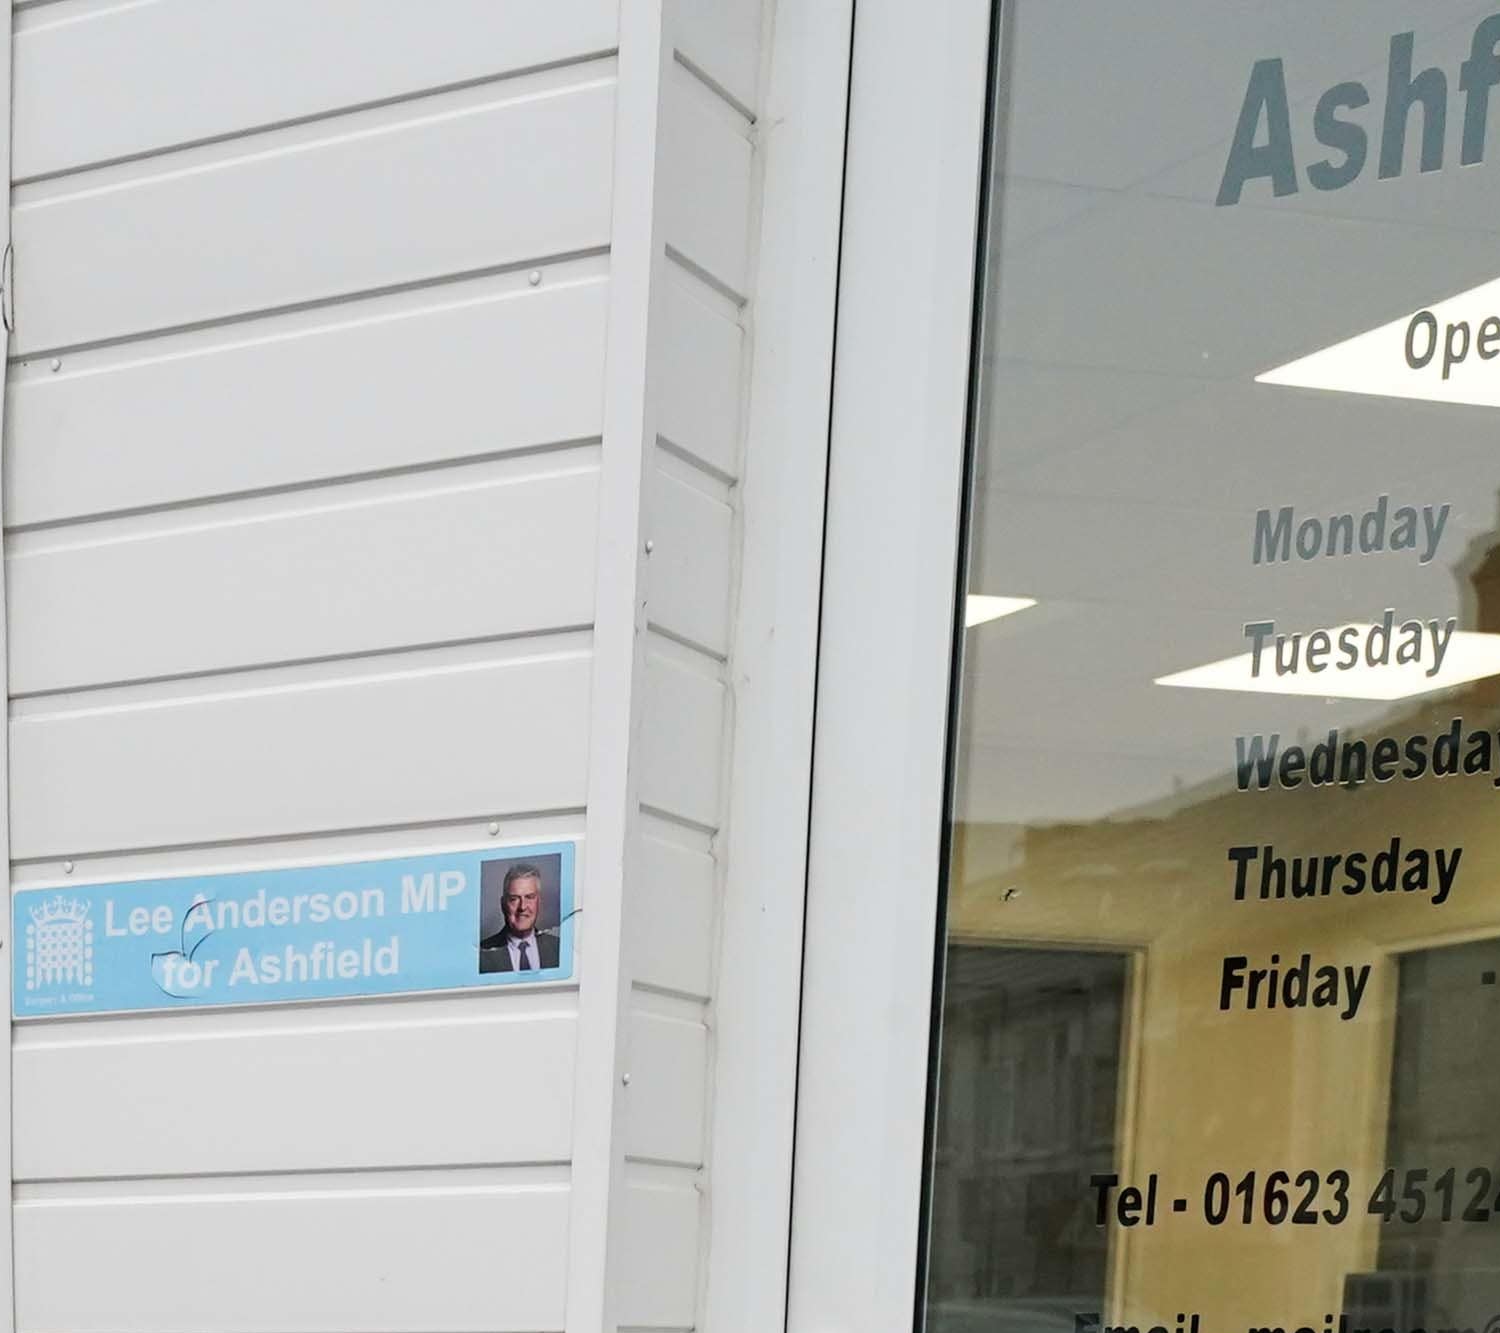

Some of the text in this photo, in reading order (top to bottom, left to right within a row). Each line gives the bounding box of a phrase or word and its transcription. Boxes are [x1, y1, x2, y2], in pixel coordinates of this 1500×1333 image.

[1252, 495, 1451, 565] Monday
[1244, 607, 1458, 677] Tuesday
[105, 870, 467, 937] Lee Anderson MP
[1228, 837, 1462, 904] Thursday
[161, 936, 399, 991] for Ashfield
[1219, 954, 1372, 1021] Friday
[1090, 1173, 1158, 1227] Tel
[1204, 1169, 1350, 1226] 01623
